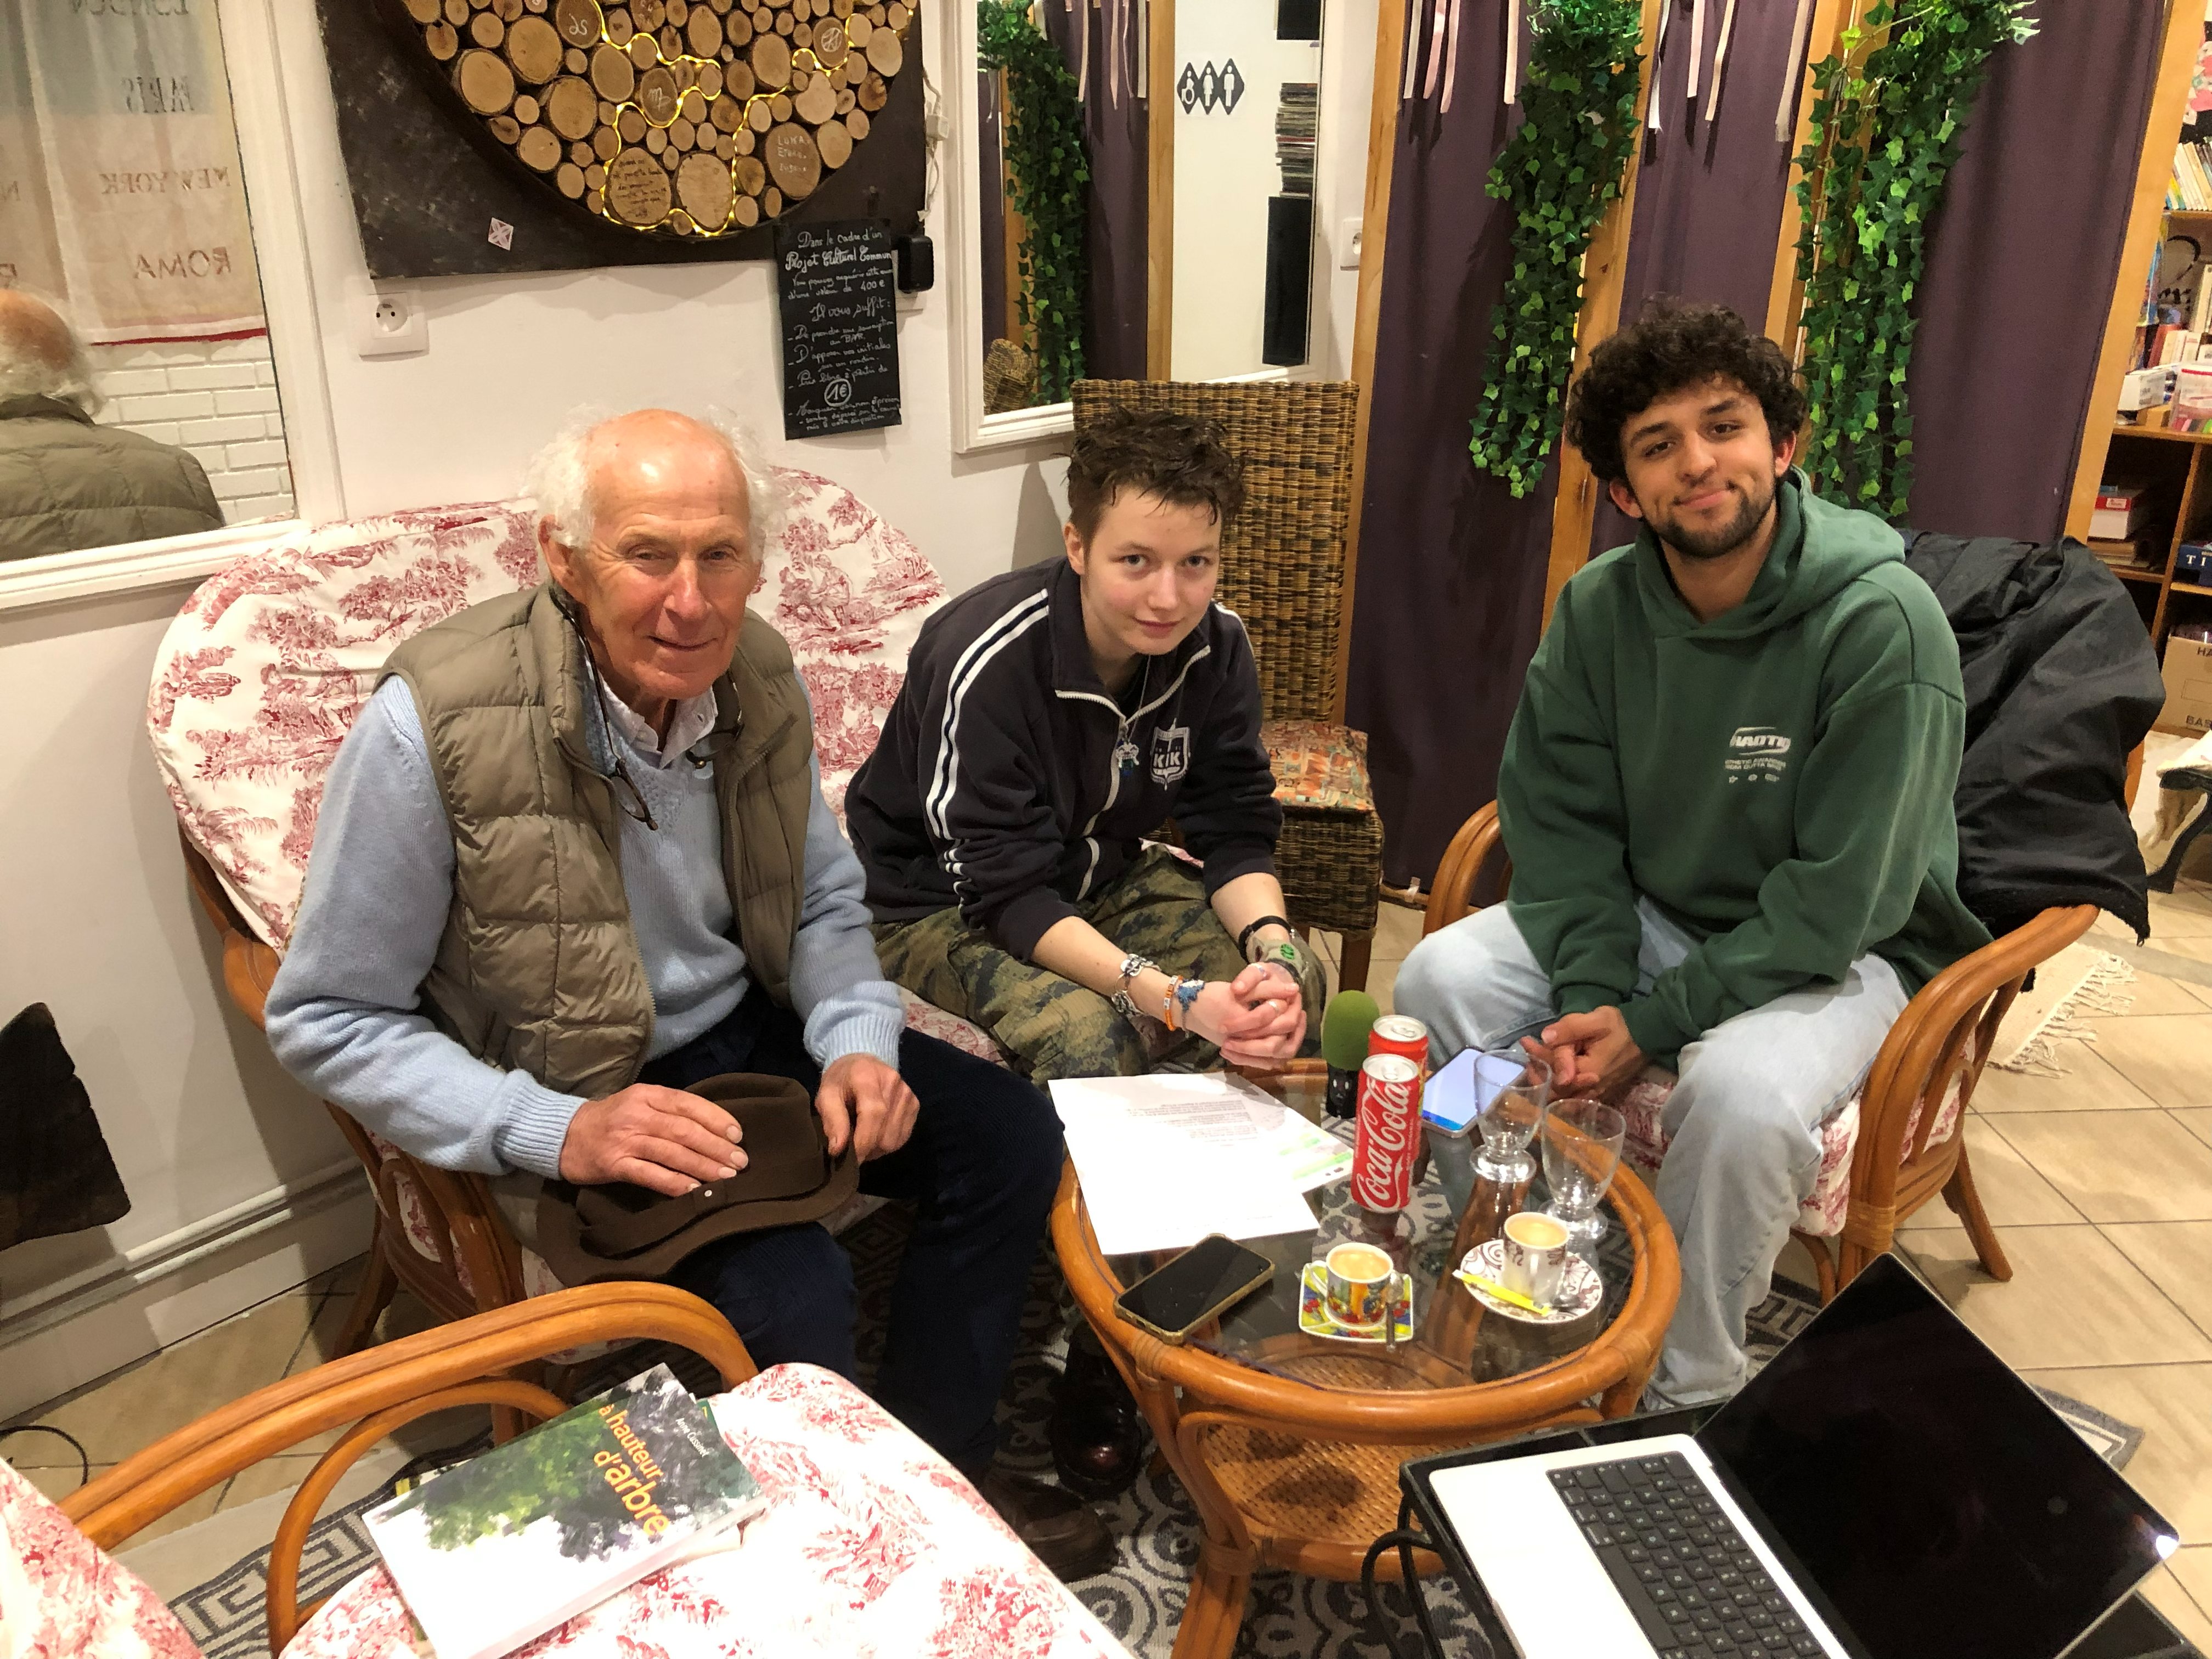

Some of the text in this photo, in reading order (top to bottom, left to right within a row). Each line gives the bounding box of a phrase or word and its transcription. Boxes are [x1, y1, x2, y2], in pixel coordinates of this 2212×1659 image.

[797, 231, 823, 249] Dans
[826, 229, 834, 246] le
[837, 231, 861, 244] cadre
[785, 245, 892, 274] Projet Culturel Commun
[860, 280, 877, 291] 400
[809, 302, 826, 322] Il
[828, 306, 851, 317] vous
[675, 1417, 691, 1434] Anne
[599, 1403, 664, 1480] à hauteur
[594, 1450, 670, 1537] d'arbre
